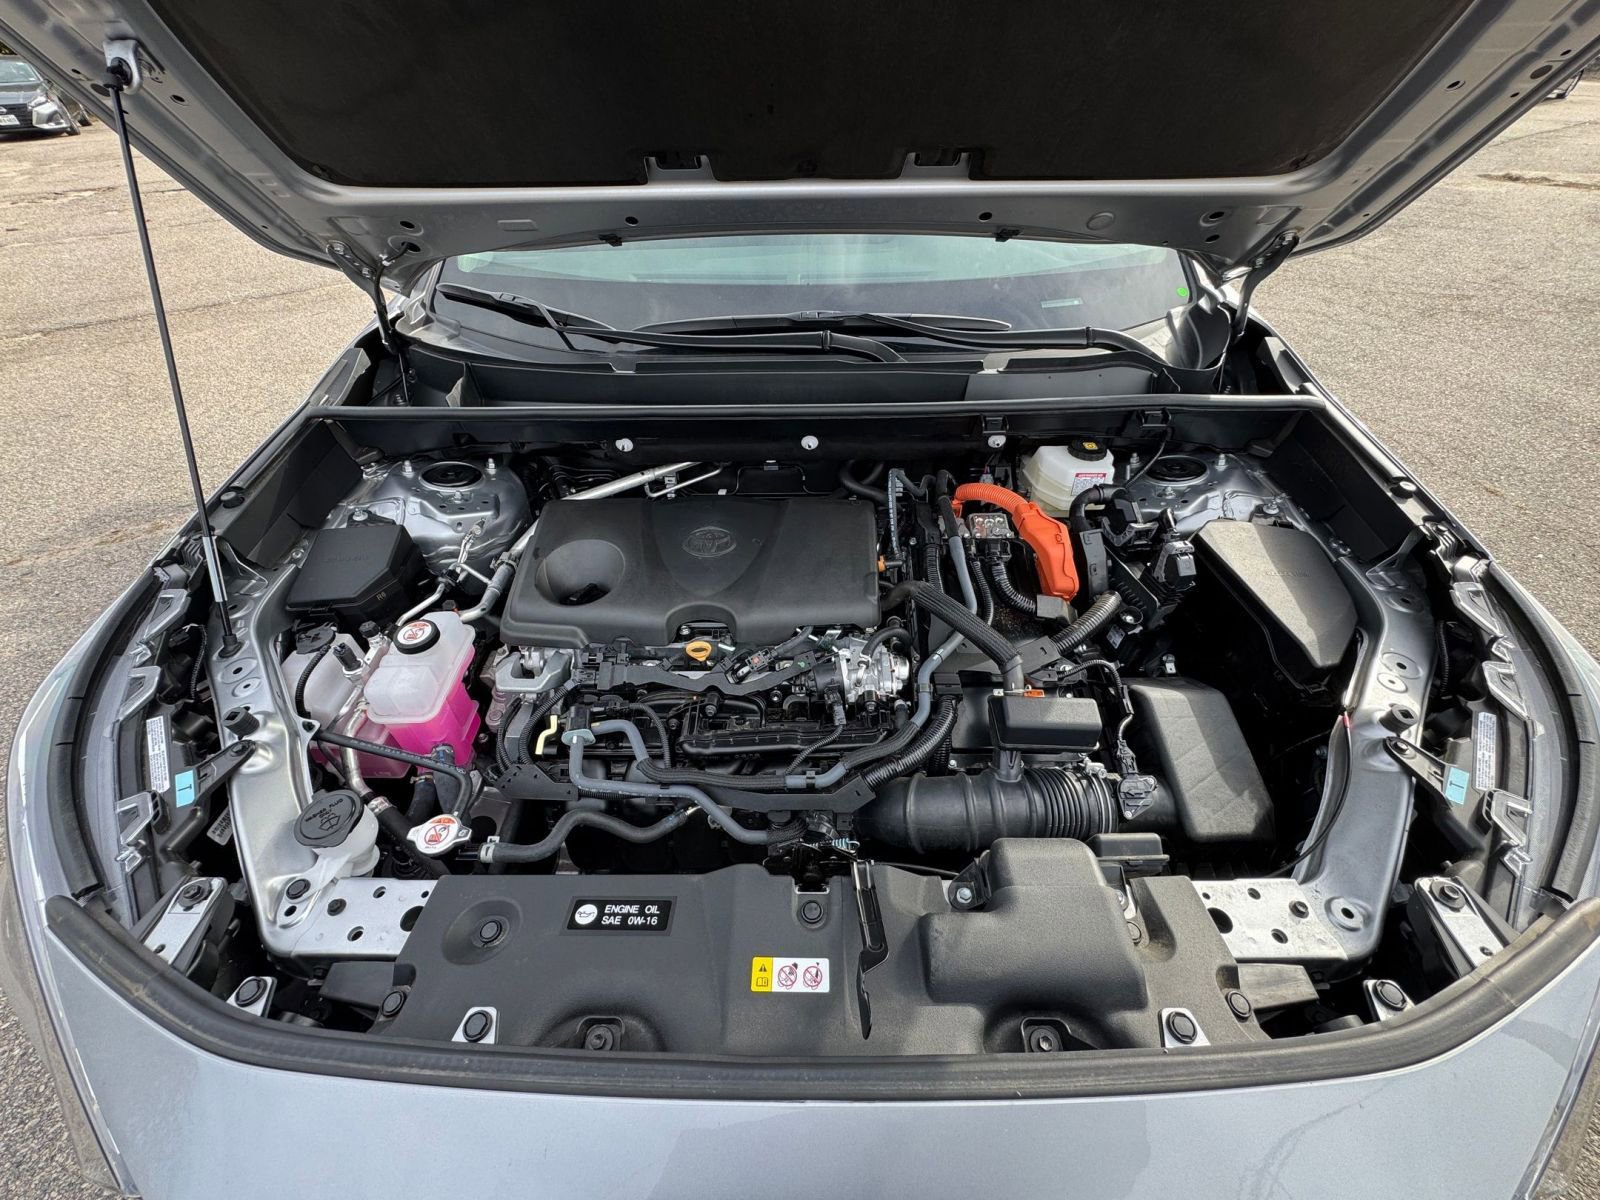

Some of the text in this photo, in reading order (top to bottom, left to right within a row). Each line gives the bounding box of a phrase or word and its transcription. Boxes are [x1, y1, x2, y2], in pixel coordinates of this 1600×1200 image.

[604, 904, 660, 914] ENGINE OIL
[601, 915, 658, 926] SAE 0W-16
